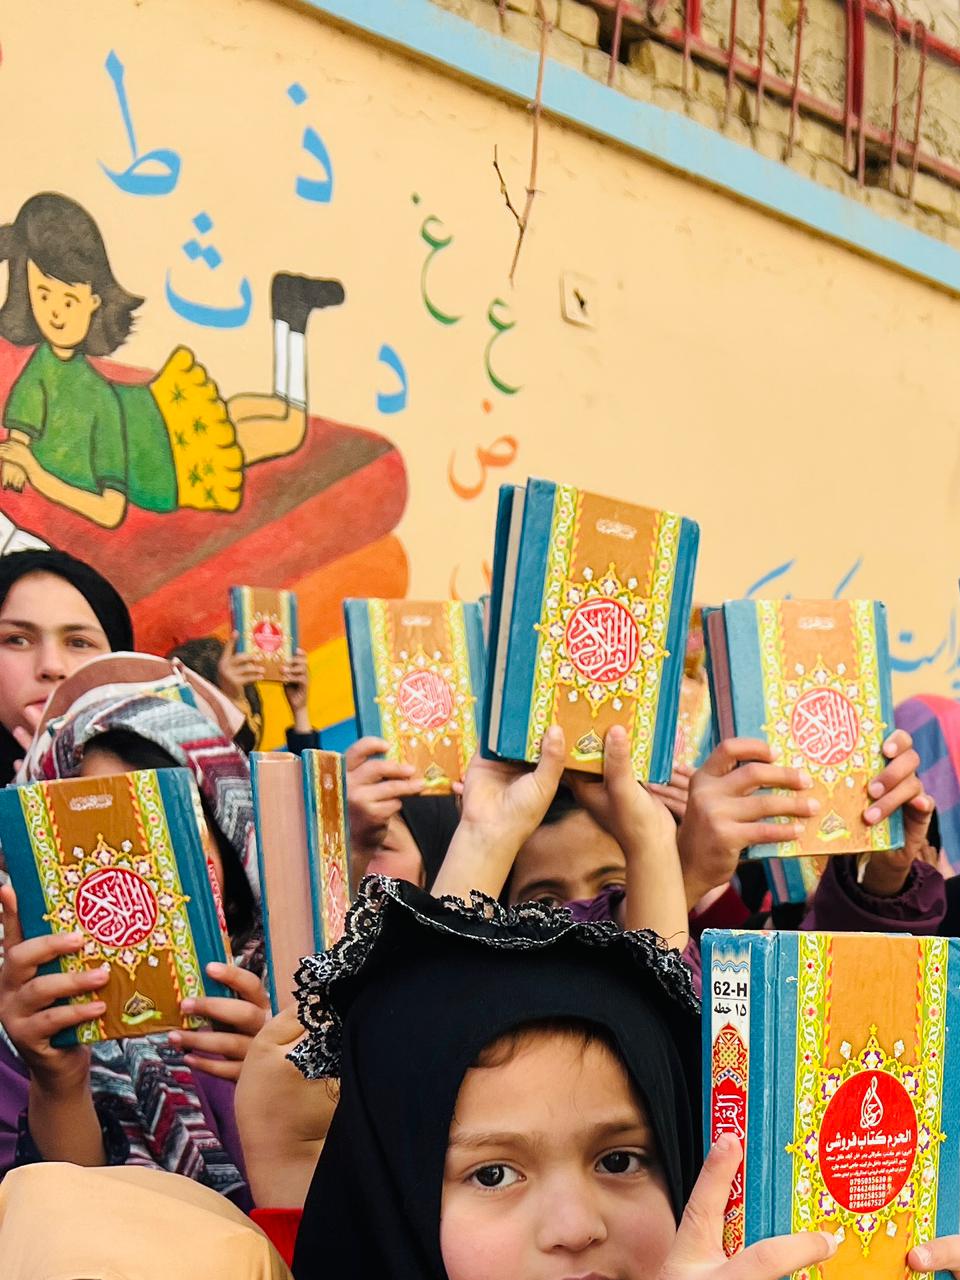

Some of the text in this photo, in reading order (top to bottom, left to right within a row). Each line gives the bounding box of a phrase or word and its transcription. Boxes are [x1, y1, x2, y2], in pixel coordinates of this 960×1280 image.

[97, 49, 181, 195] ط
[286, 82, 333, 203] ذ
[165, 210, 253, 329] ث
[410, 191, 463, 325] غ
[376, 343, 408, 414] د
[484, 298, 524, 394] ع
[447, 400, 518, 500] ض
[713, 981, 748, 998] 62-H
